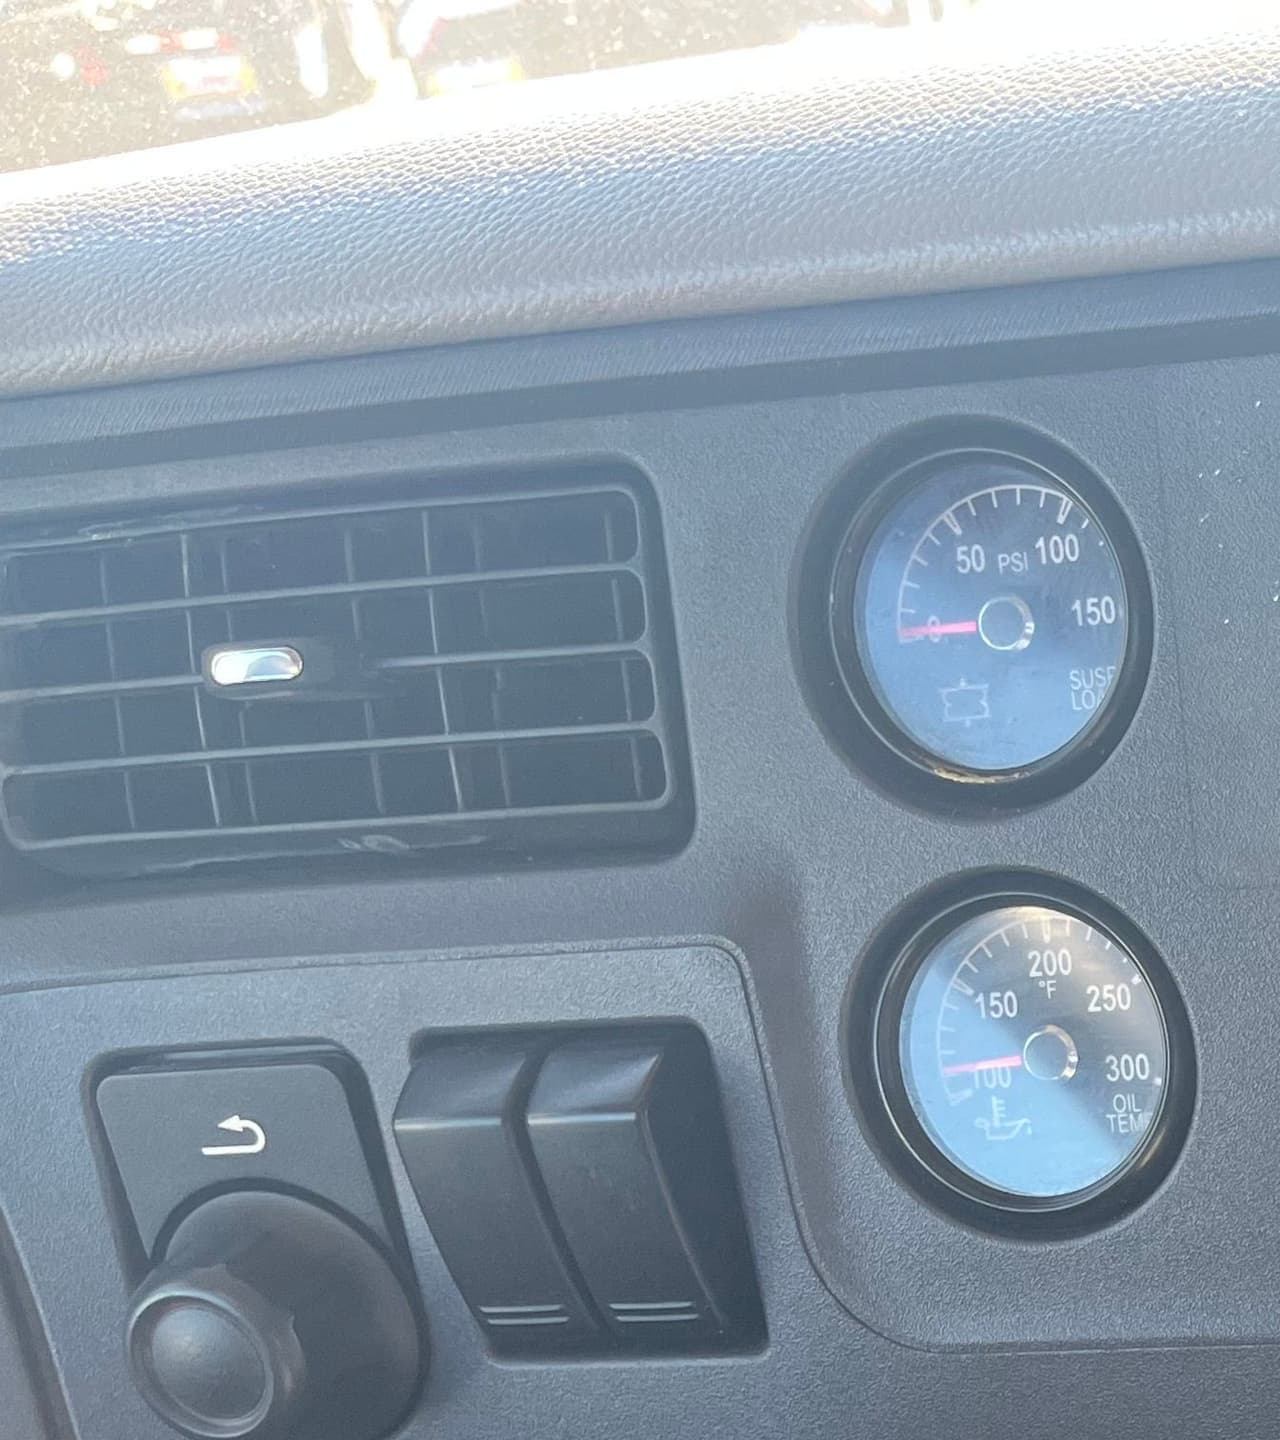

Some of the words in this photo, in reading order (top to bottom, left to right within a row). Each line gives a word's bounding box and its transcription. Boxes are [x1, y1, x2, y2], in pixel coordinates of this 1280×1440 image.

[956, 544, 986, 574] 50
[997, 551, 1029, 575] PSI
[1034, 534, 1080, 565] 100
[1071, 596, 1116, 627] 150
[1027, 950, 1072, 977] 200
[975, 991, 1018, 1019] 150
[1087, 984, 1131, 1012] 250
[973, 1065, 1012, 1090] 100
[1105, 1054, 1150, 1082] 300
[1112, 1094, 1141, 1113] OIL
